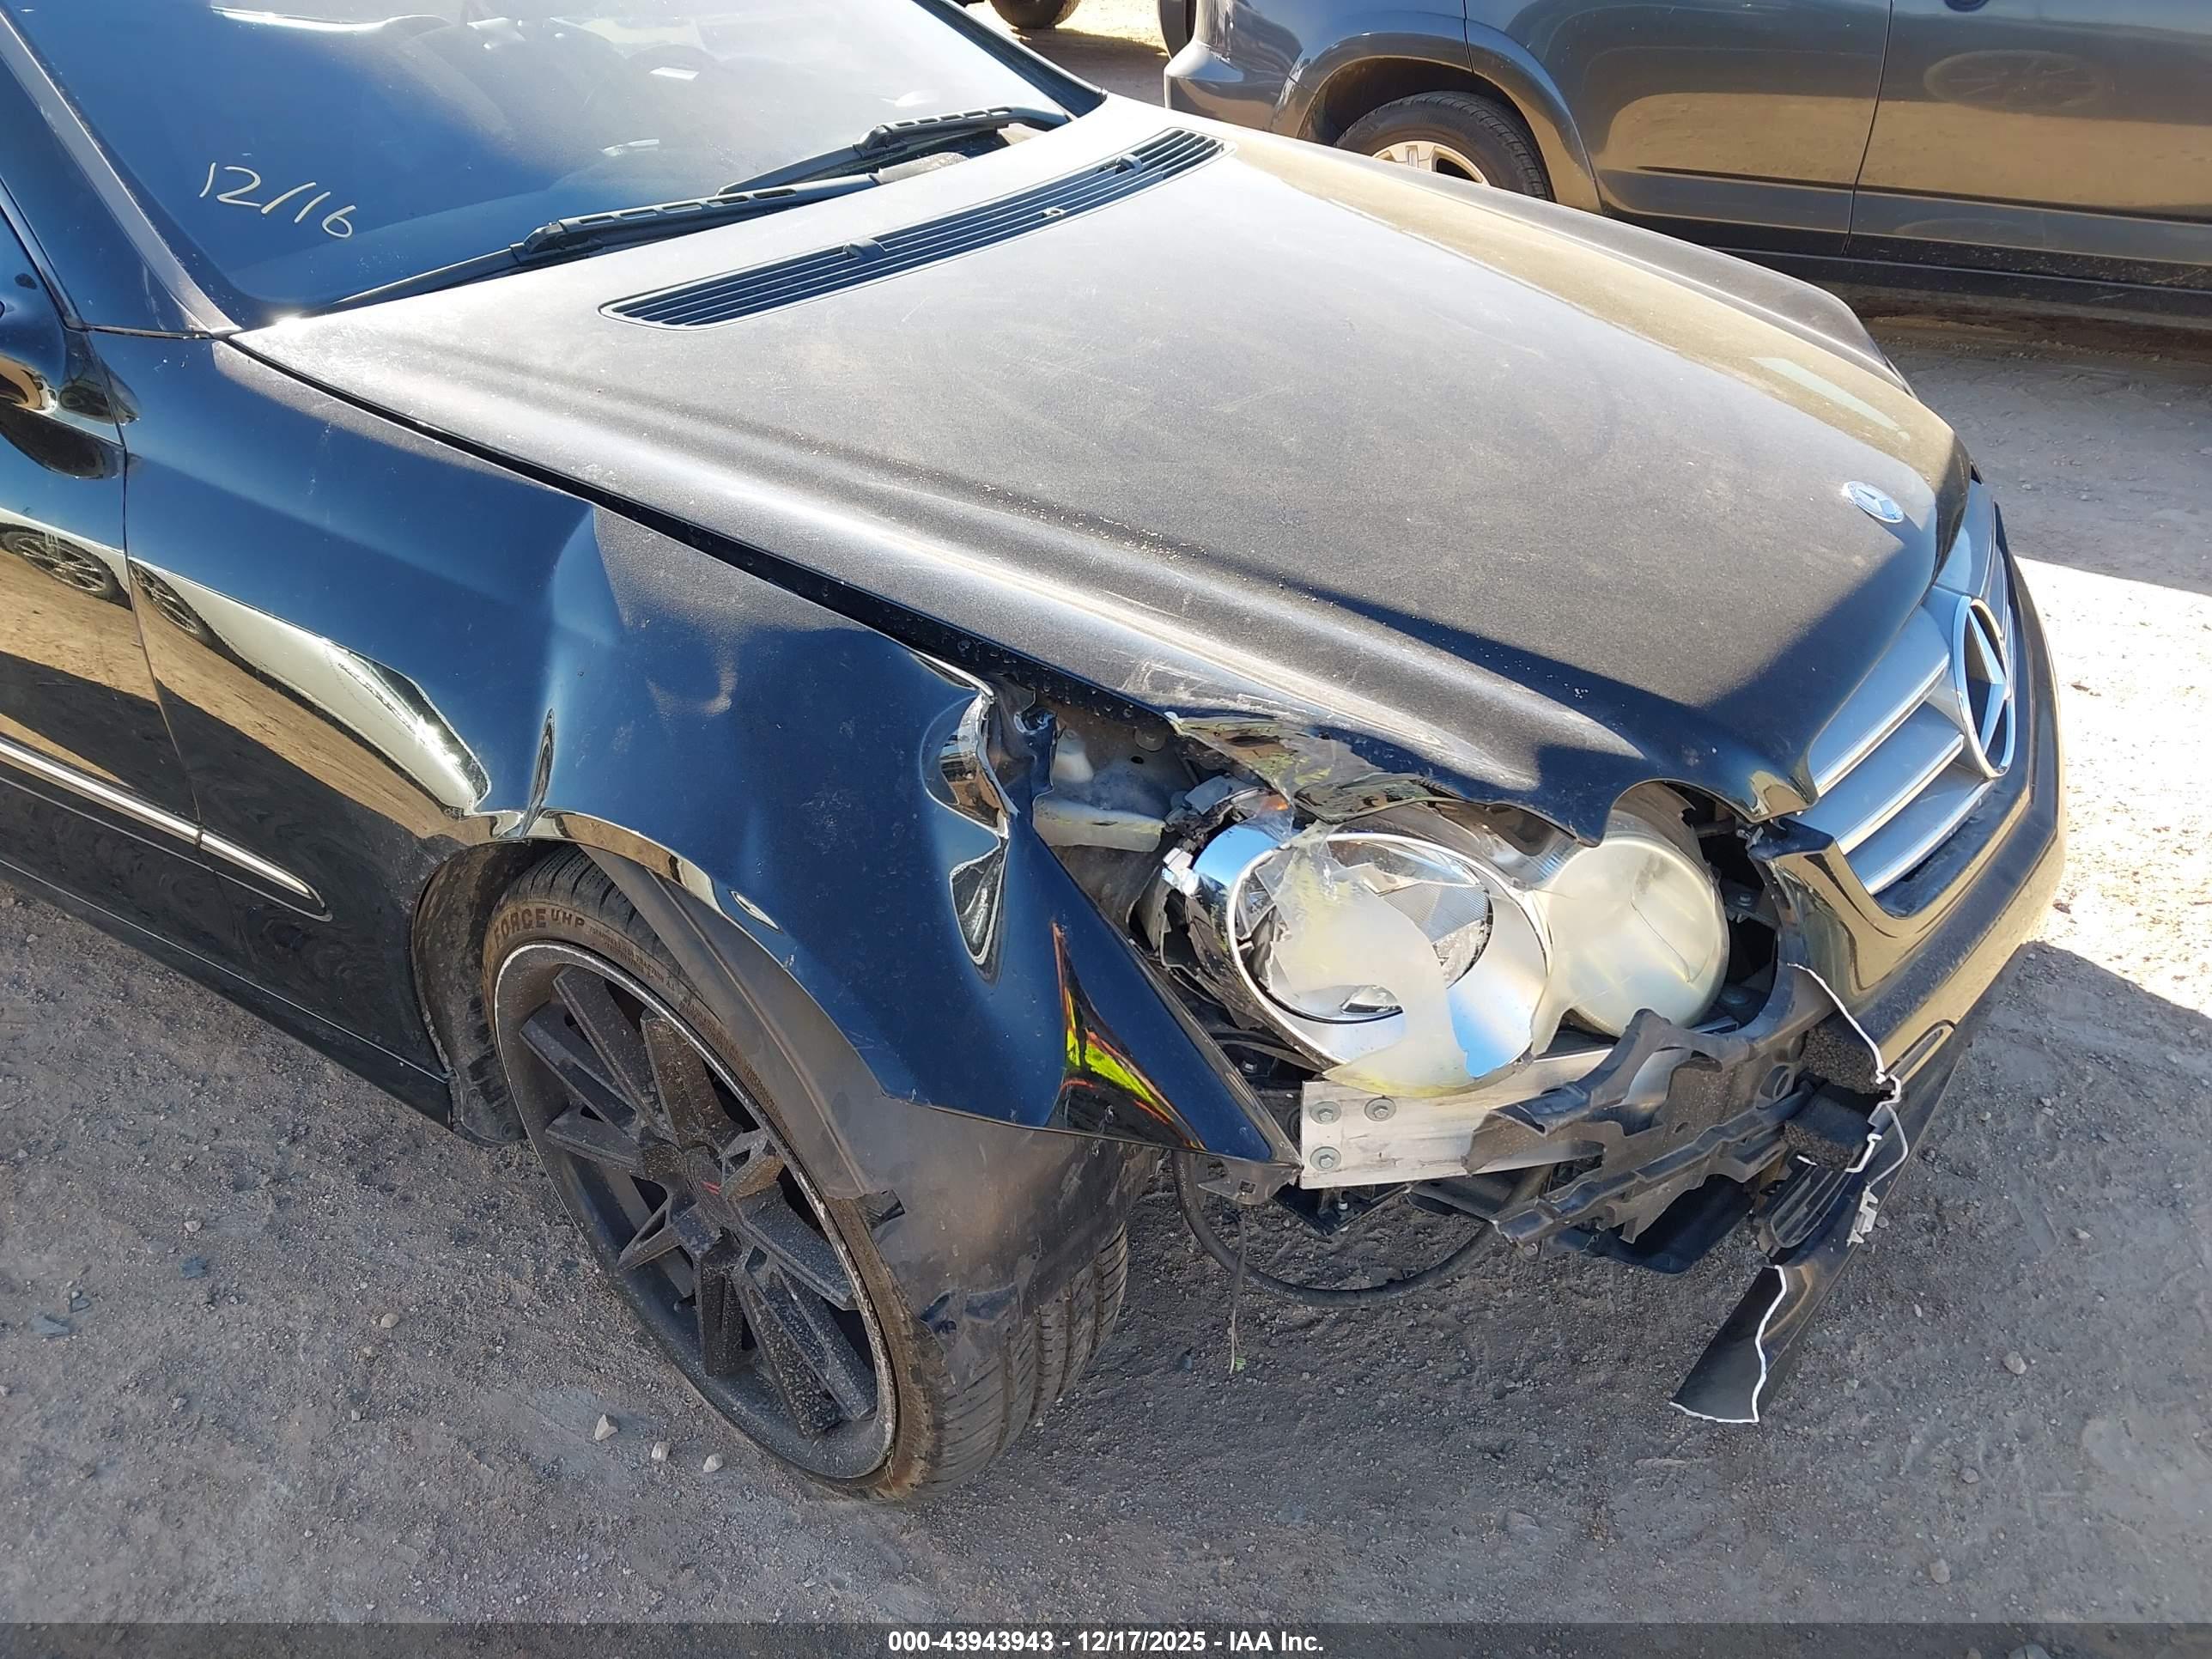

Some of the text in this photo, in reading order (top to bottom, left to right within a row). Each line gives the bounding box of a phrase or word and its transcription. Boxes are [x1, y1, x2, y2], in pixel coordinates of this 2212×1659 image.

[198, 161, 357, 239] 12/16
[494, 908, 585, 949] FORCE UHP
